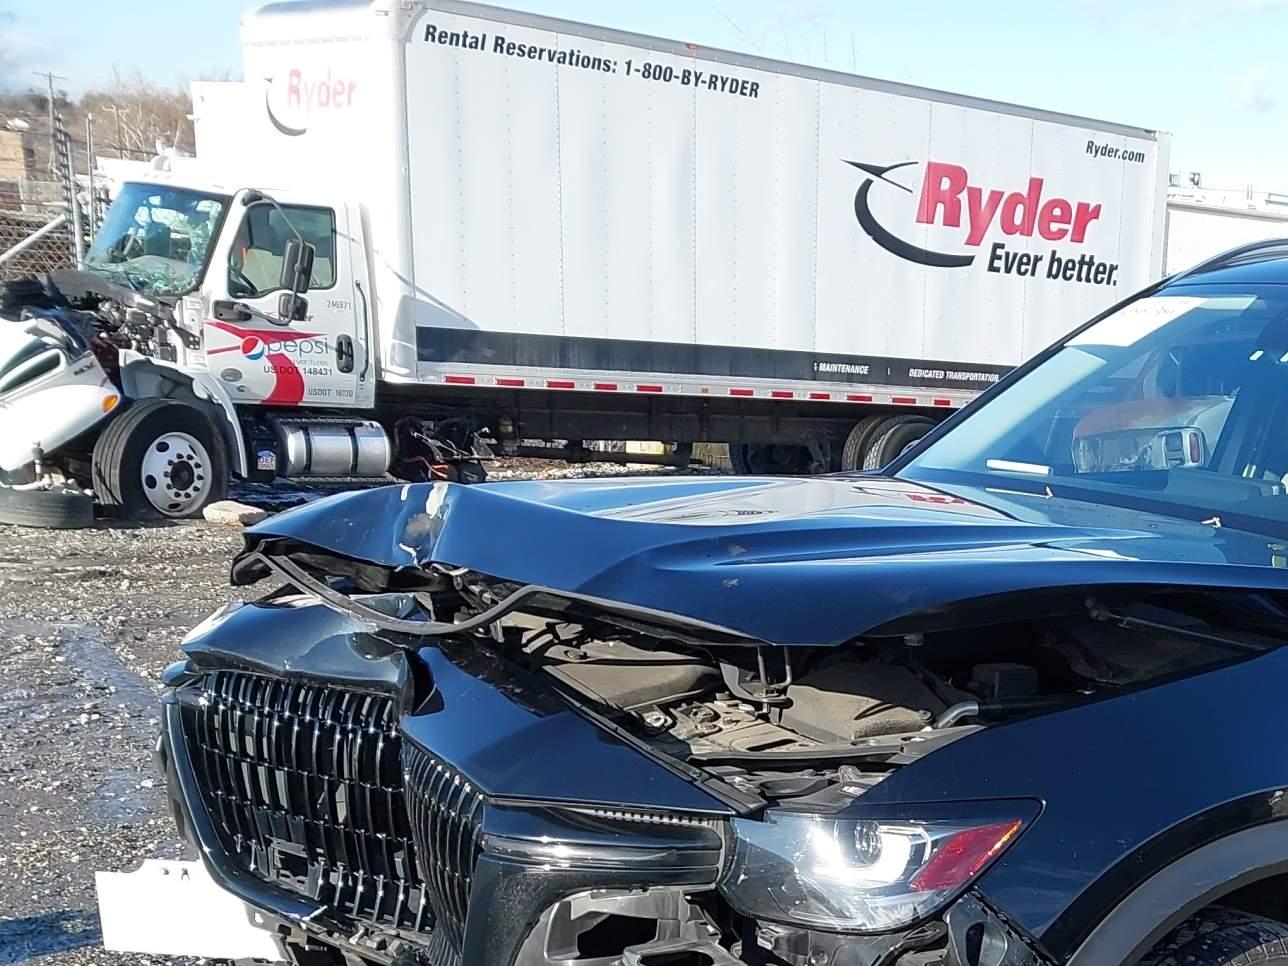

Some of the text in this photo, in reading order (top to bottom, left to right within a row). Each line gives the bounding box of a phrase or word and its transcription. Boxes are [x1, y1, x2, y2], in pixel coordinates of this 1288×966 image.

[424, 24, 760, 99] Rental Reservations: 1-800-BY-RYDER
[288, 67, 357, 114] Ryder
[1085, 140, 1145, 163] Ryder.com
[915, 161, 1102, 246] Ryder
[986, 242, 1118, 286] Ever better.
[267, 338, 329, 357] pepsi
[263, 365, 277, 374] US
[303, 367, 333, 376] 148431
[819, 363, 869, 375] MAINTENANCE
[908, 368, 944, 379] DEDICATED
[946, 371, 999, 382] TRANSPORTATION
[308, 388, 332, 397] USDOT
